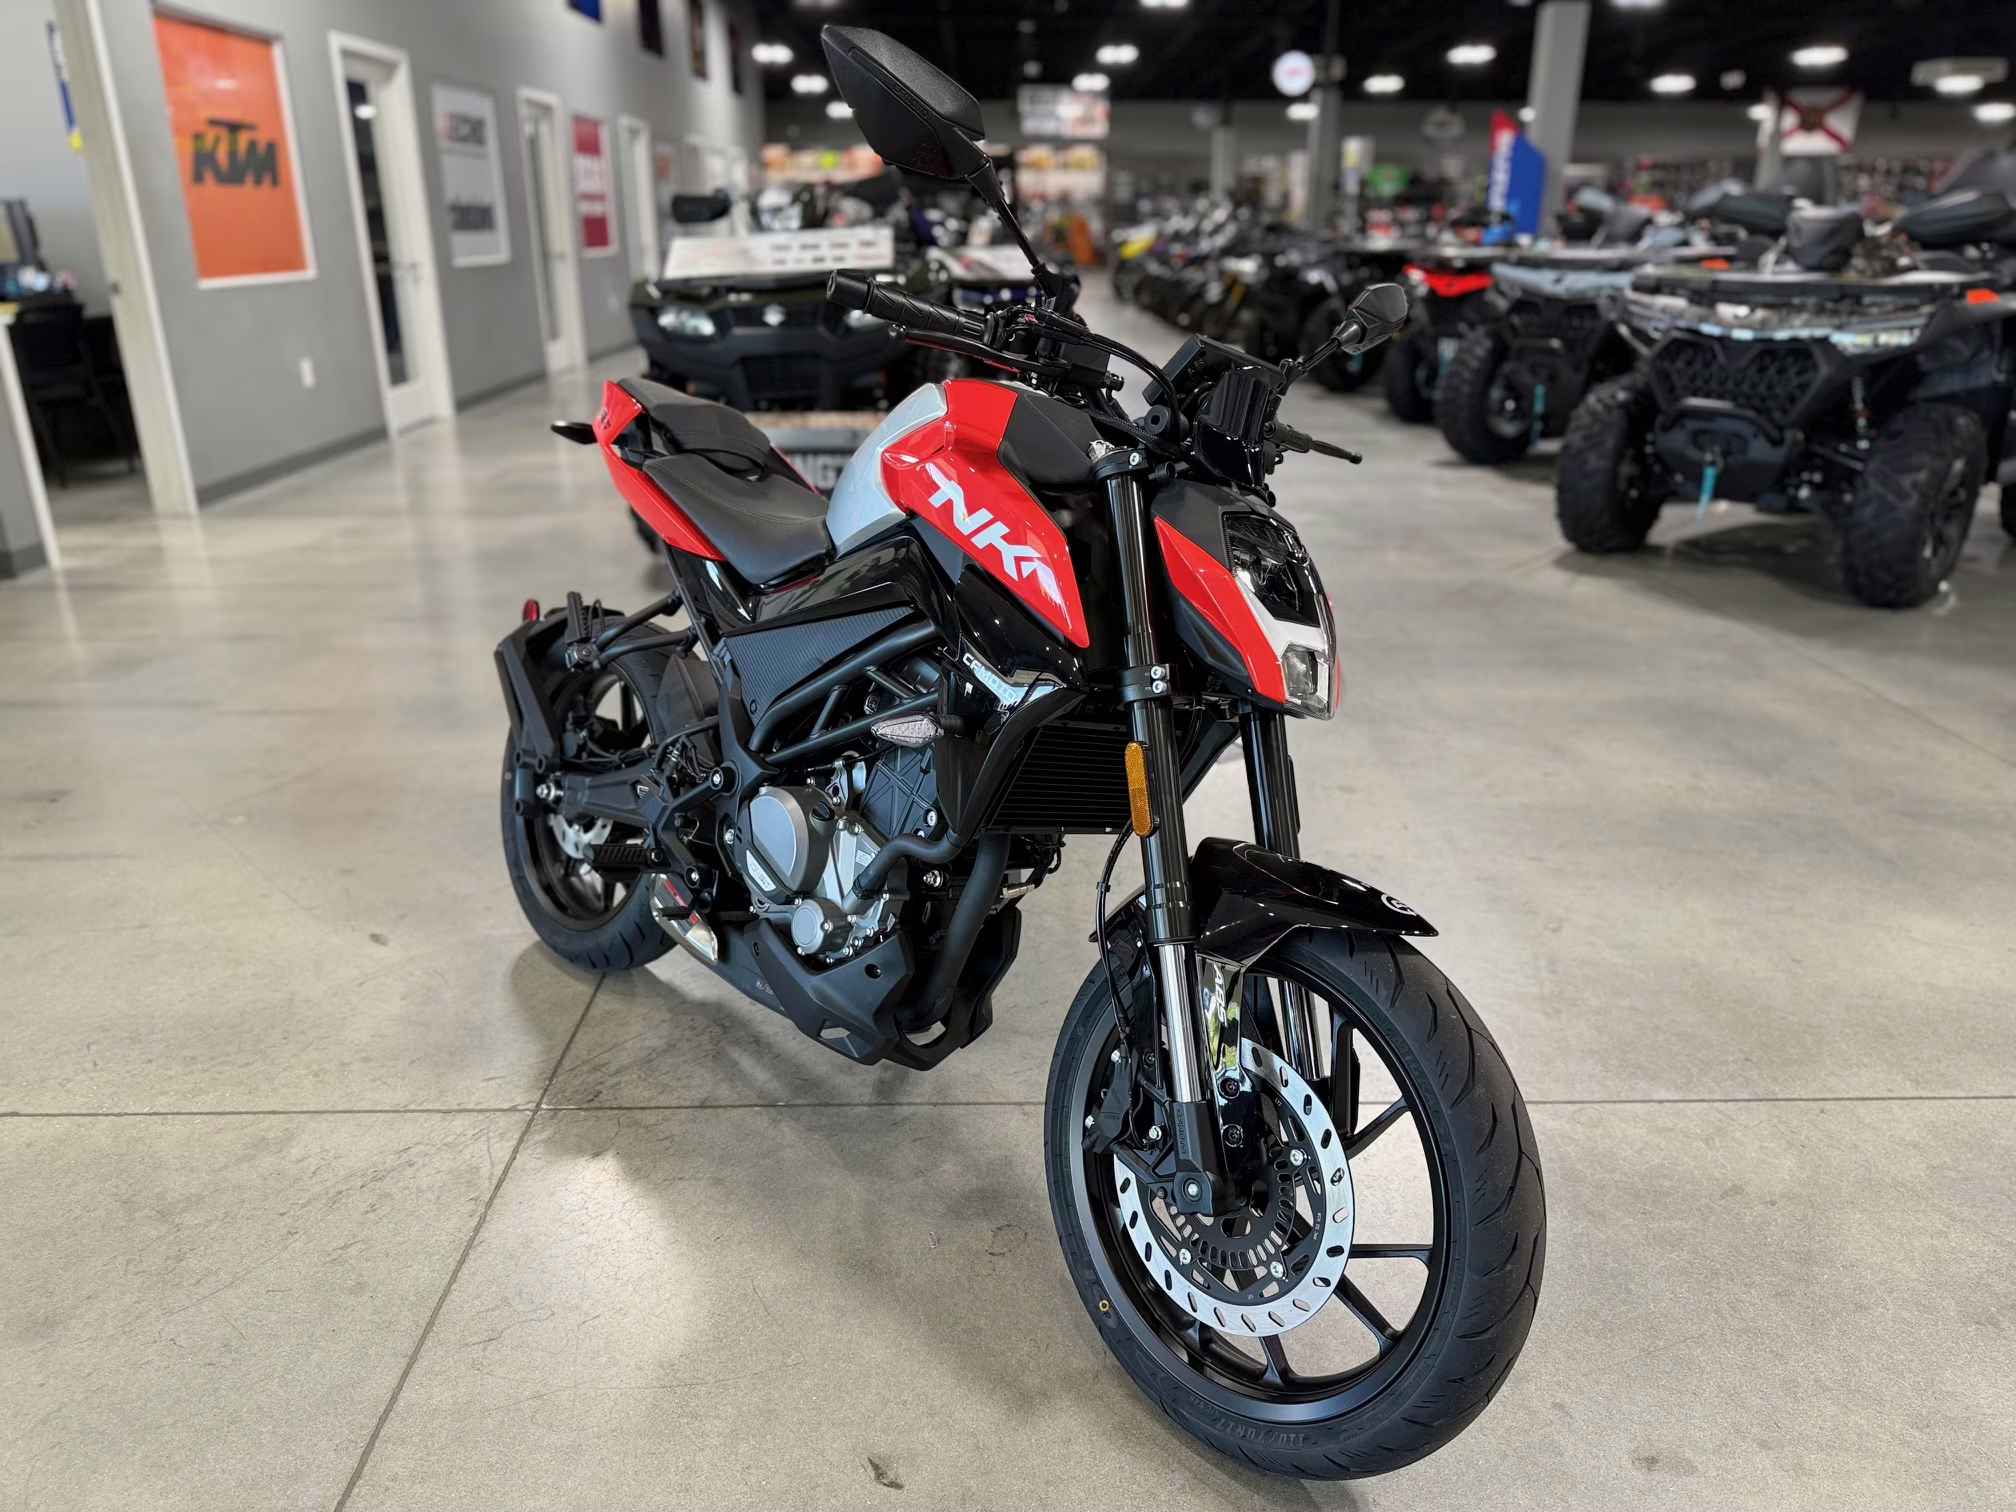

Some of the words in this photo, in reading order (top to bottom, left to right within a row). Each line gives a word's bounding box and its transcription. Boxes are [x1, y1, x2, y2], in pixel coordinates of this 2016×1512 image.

[891, 83, 930, 119] CFMOTO
[193, 119, 278, 188] KTM
[928, 479, 1042, 582] NK
[962, 652, 1017, 703] CFMOTO
[1213, 962, 1228, 1029] ABS
[1216, 1417, 1305, 1448] 110/70R17
